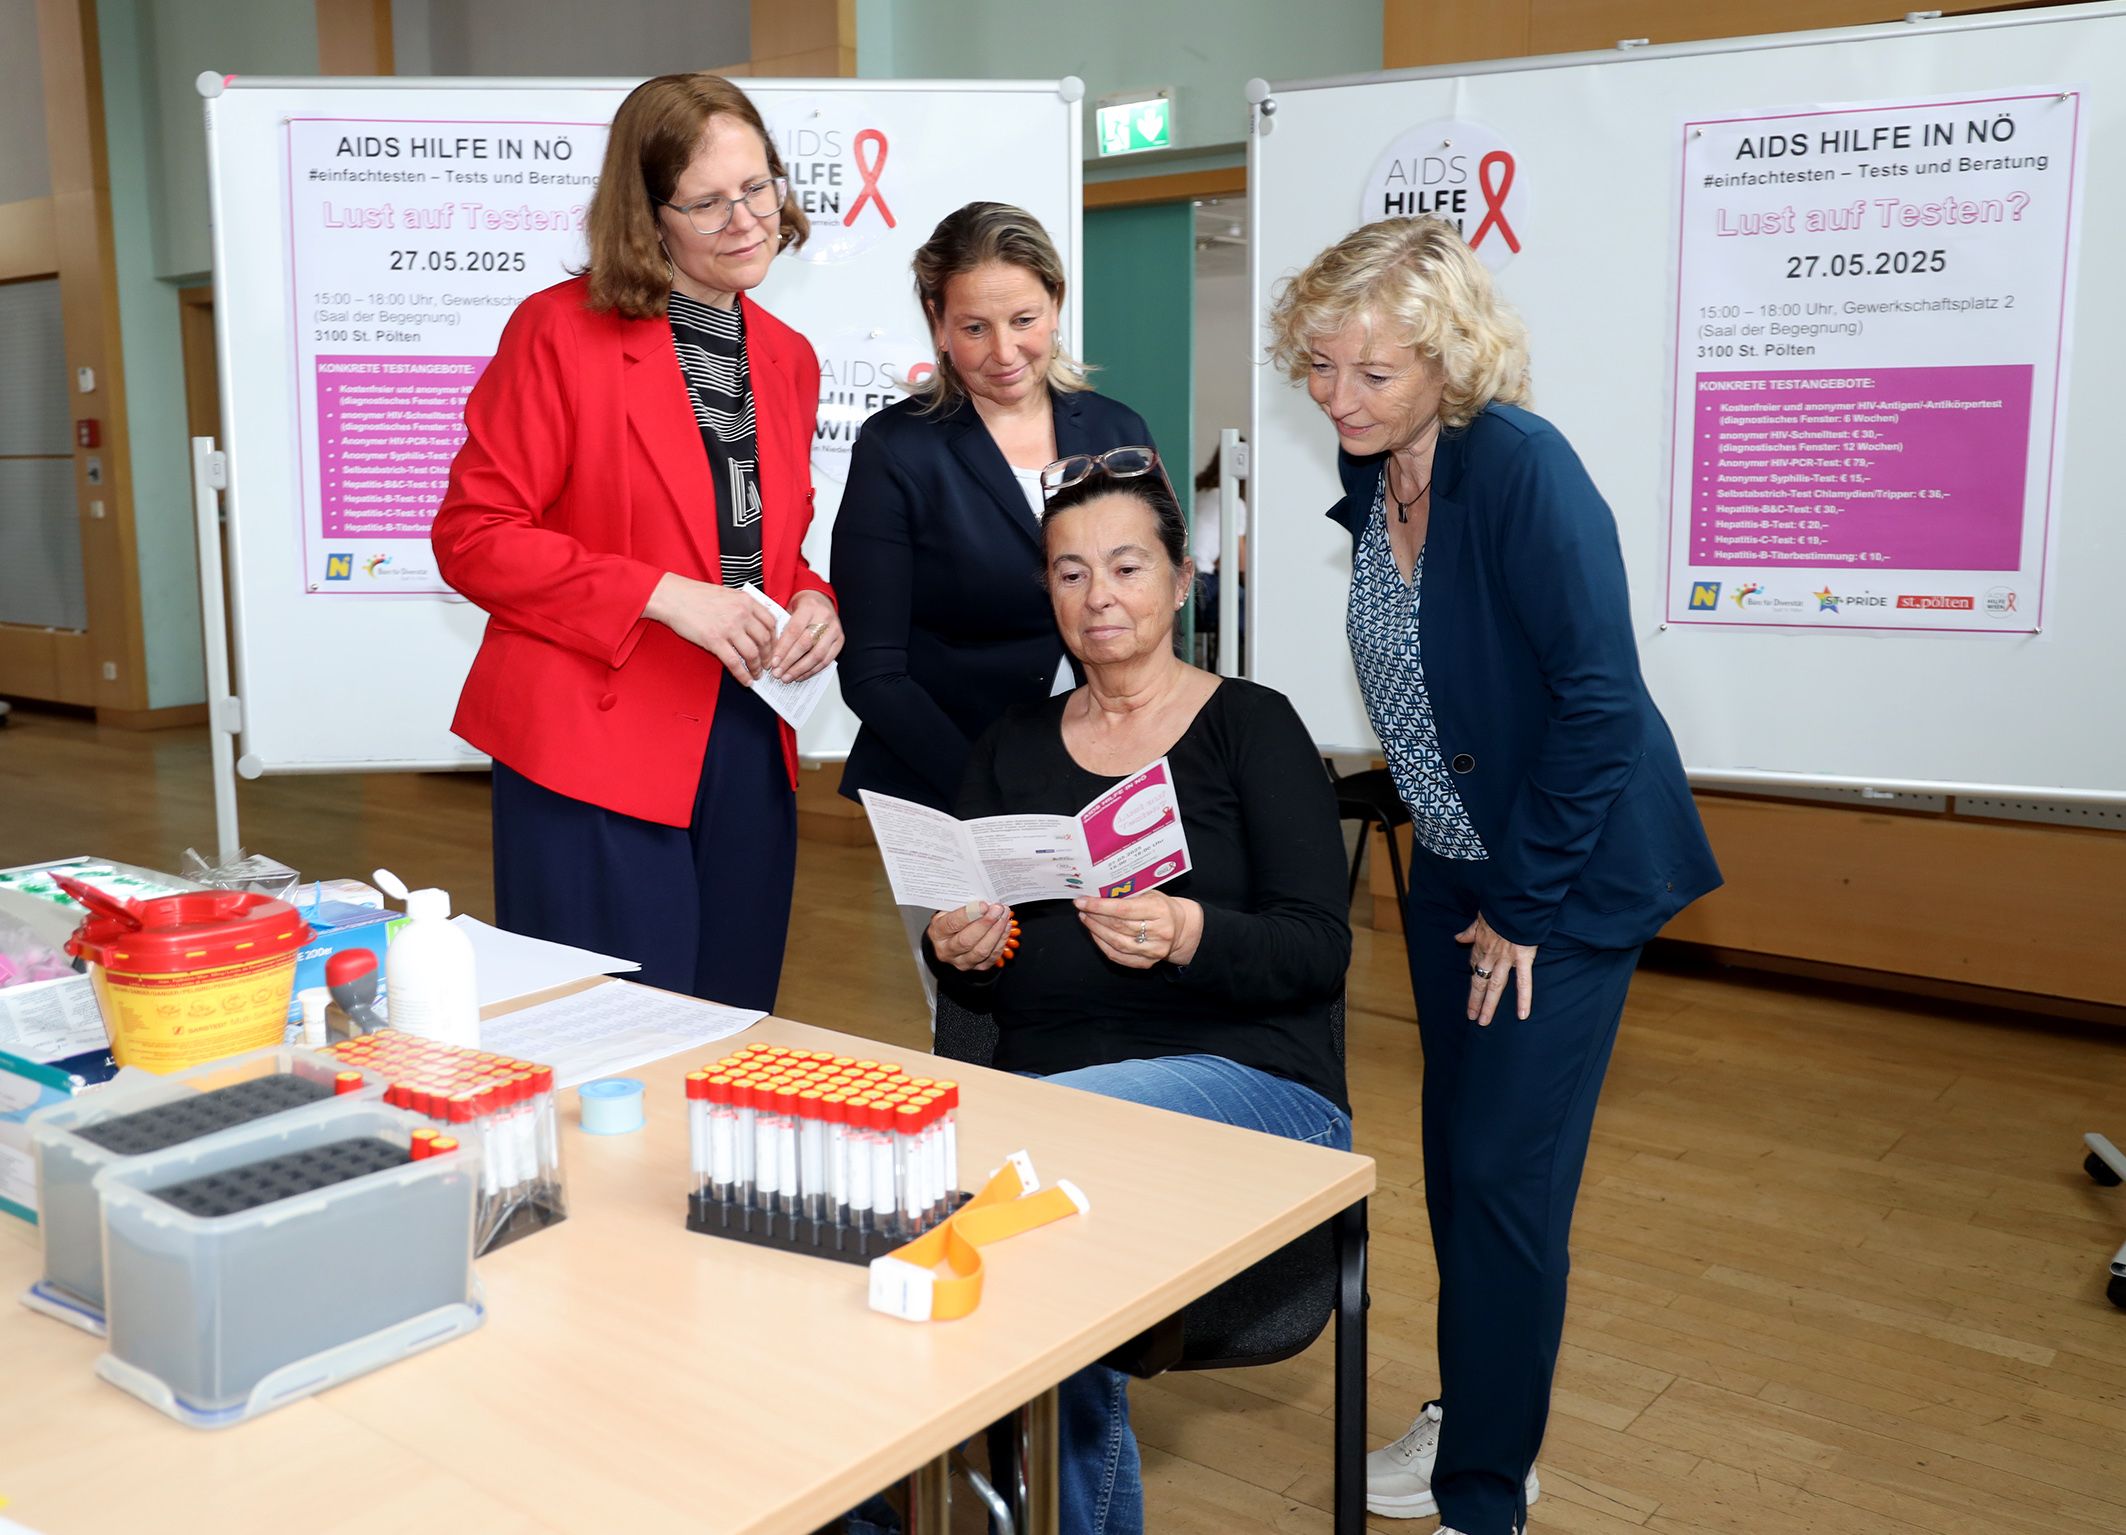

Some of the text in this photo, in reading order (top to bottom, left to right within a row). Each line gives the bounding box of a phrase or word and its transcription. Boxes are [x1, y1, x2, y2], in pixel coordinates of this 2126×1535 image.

[788, 129, 842, 158] IDS
[1736, 113, 2016, 160] AIDS HILFE IN NÖ
[336, 136, 573, 161] AIDS HILFE IN NÖ
[309, 168, 426, 183] #einfachtesten
[445, 170, 489, 184] Tests
[494, 171, 523, 184] und
[529, 172, 600, 187] Beratung
[1385, 155, 1468, 186] AIDS
[1704, 168, 1835, 188] #einfachtesten
[1858, 164, 1909, 179] Tests
[1916, 160, 1951, 176] und
[1959, 155, 2049, 174] Beratung
[1384, 189, 1468, 215] HILFE
[322, 202, 586, 232] Lust auf Testen?
[1716, 191, 2030, 237] Lust auf Testen?
[390, 250, 527, 273] 27.05.2025
[1786, 250, 1946, 279] 27.05.2025
[314, 293, 351, 306] 15:00
[368, 293, 406, 306] 18:00
[409, 293, 437, 307] Uhr,
[442, 294, 530, 307] Gewerkscha
[1699, 305, 1740, 319] 15:00
[1760, 304, 1801, 318] 18:00
[1806, 302, 1837, 317] Uhr,
[1843, 297, 1999, 316] Gewerkschaftsplatz
[2004, 295, 2015, 309] 2
[314, 309, 461, 326] (Saal der Begegnung)
[315, 330, 421, 342] 3100 St. Pölten
[1698, 319, 1863, 339] (Saal der Begegnung)
[1697, 343, 1816, 358] 3100 St. Pölten
[318, 363, 475, 375] KONKRETE TESTANGEBOTE:
[820, 359, 896, 390] AIDS
[1699, 378, 1875, 391] KONKRETE TESTANGEBOTE:
[1719, 402, 1781, 412] Kostenfreier
[1783, 403, 1801, 412] und
[1804, 403, 1856, 413] anonymer
[1719, 415, 1798, 426] (diagnostisches
[1801, 414, 1842, 425] Fenster:
[1853, 413, 1899, 424] Wochen)
[1719, 432, 1768, 441] anonymer
[1770, 430, 1850, 440] HIV-Schnelltest:
[1852, 430, 1860, 439] €
[1718, 442, 1903, 454] (diagnostisches Fenster: 12 Wochen)
[1718, 459, 1769, 469] Anonymer
[1770, 458, 1842, 468] HIV-PCR-Test:
[1843, 458, 1852, 467] €
[1717, 474, 1768, 484] Anonymer
[1770, 473, 1838, 484] Syphilis-Test:
[1839, 474, 1848, 483] €
[1717, 489, 1812, 499] Selbstabstrich-Test
[1918, 490, 1927, 499] €
[1814, 505, 1822, 514] €
[1714, 519, 1797, 530] Hepatitis-B-Test:
[1798, 520, 1806, 529] €
[1714, 535, 1796, 545] Hepatitis-C-Test:
[1797, 536, 1806, 545] €
[1859, 552, 1867, 561] €
